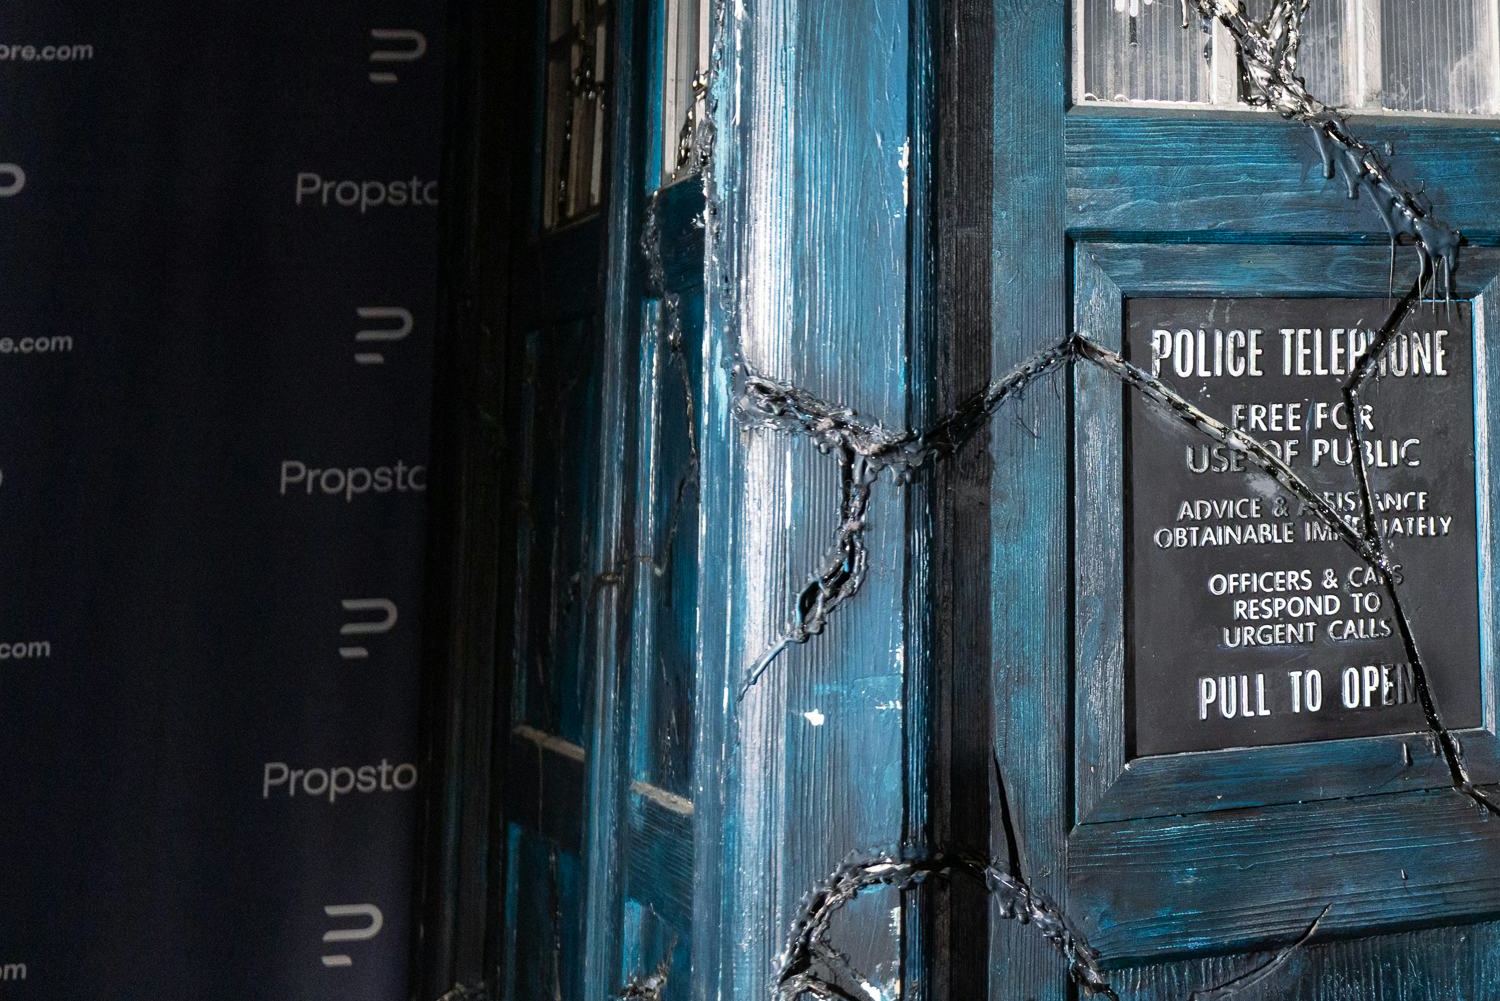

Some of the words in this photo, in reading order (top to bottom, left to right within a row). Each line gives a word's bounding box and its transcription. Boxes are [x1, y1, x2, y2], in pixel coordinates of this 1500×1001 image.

[1151, 328, 1264, 379] POLICE
[1231, 402, 1302, 432] FREE
[1186, 443, 1249, 474] USE
[1177, 497, 1262, 522] ADVICE
[1272, 496, 1289, 518] &
[1154, 522, 1295, 549] OBTAINABLE
[1208, 568, 1314, 596] OFFICERS
[1322, 567, 1340, 590] &
[1348, 563, 1405, 588] CAS
[1233, 595, 1342, 621] RESPOND
[1350, 591, 1382, 614] TO
[1223, 621, 1318, 649] URGENT
[1327, 617, 1394, 642] CALLS
[1198, 672, 1272, 722] PULL
[1287, 669, 1323, 714] TO
[1341, 662, 1418, 710] OPEN
[262, 758, 418, 803] Propsto
